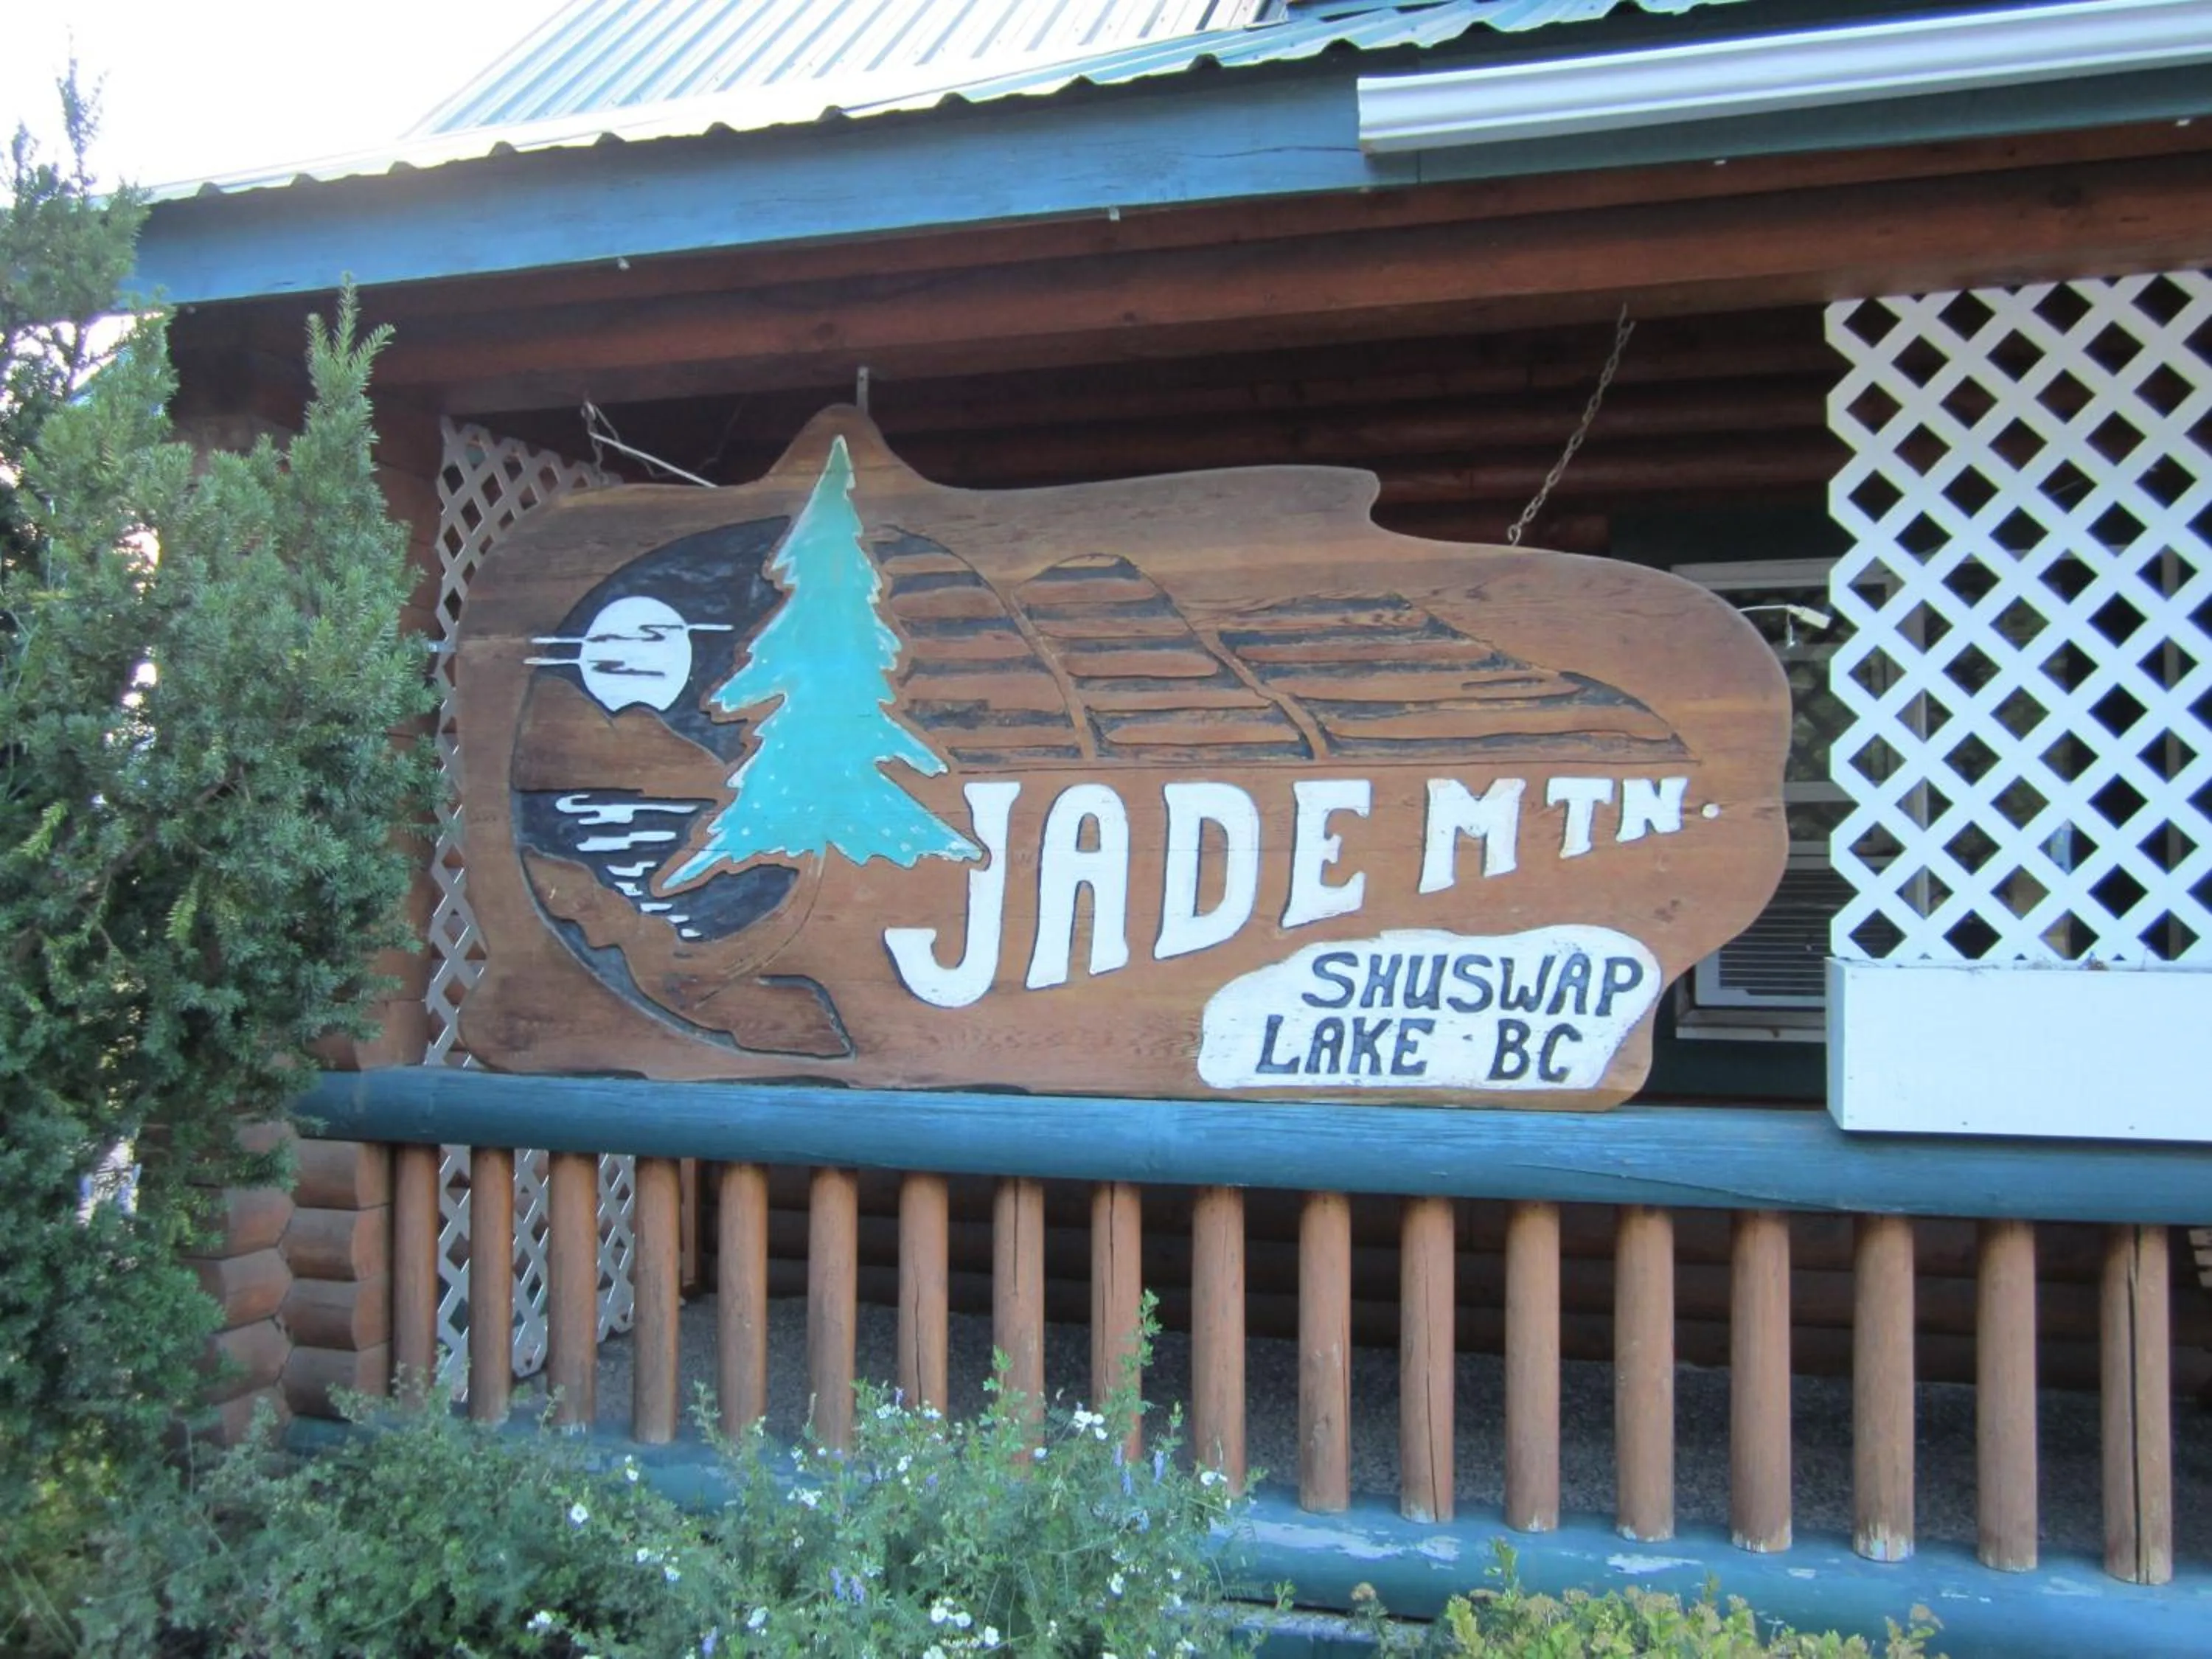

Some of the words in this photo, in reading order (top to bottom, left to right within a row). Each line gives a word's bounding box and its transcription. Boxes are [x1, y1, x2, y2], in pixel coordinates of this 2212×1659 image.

[884, 779, 1371, 1007] JADE
[1301, 952, 1644, 1017] SHUSWAP
[1256, 1015, 1436, 1076] LAKE
[1489, 1018, 1582, 1082] BC
